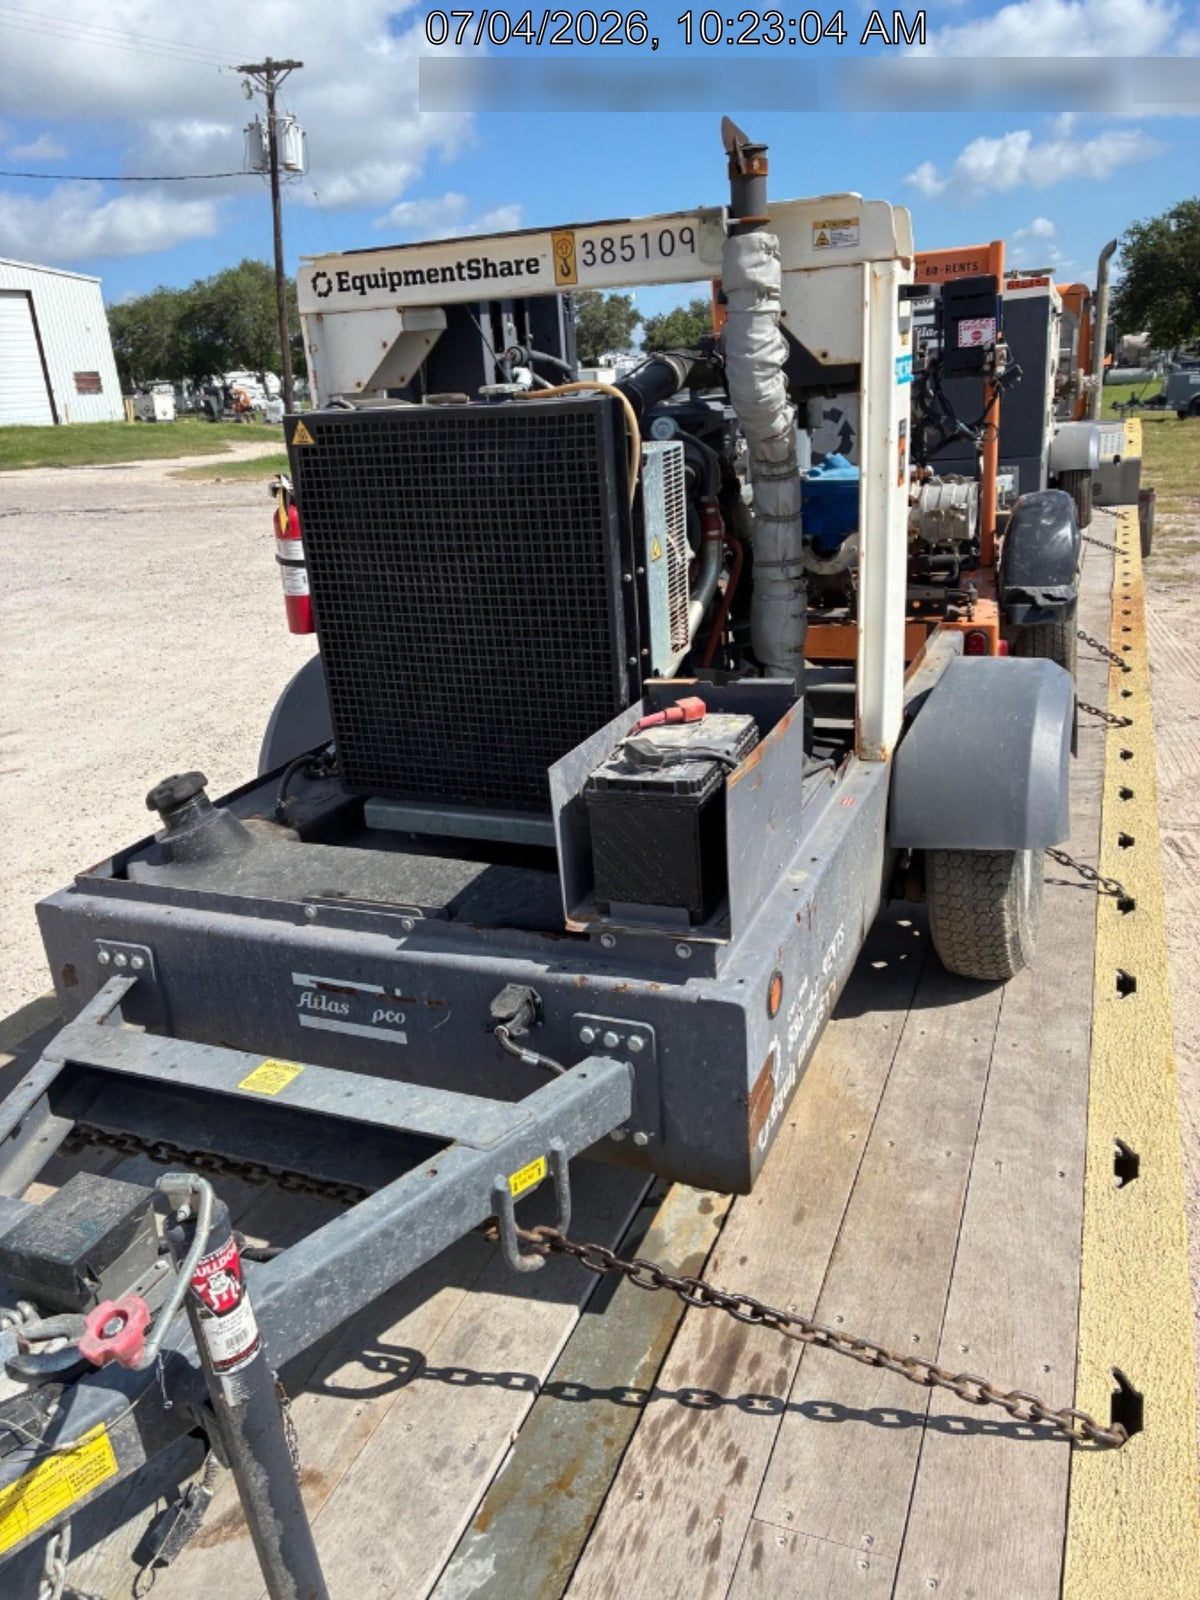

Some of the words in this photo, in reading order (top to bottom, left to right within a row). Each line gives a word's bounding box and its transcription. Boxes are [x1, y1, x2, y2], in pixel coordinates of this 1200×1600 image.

[581, 226, 696, 267] 385109
[336, 257, 541, 296] EquipmentShare
[296, 991, 350, 1014] Atlas
